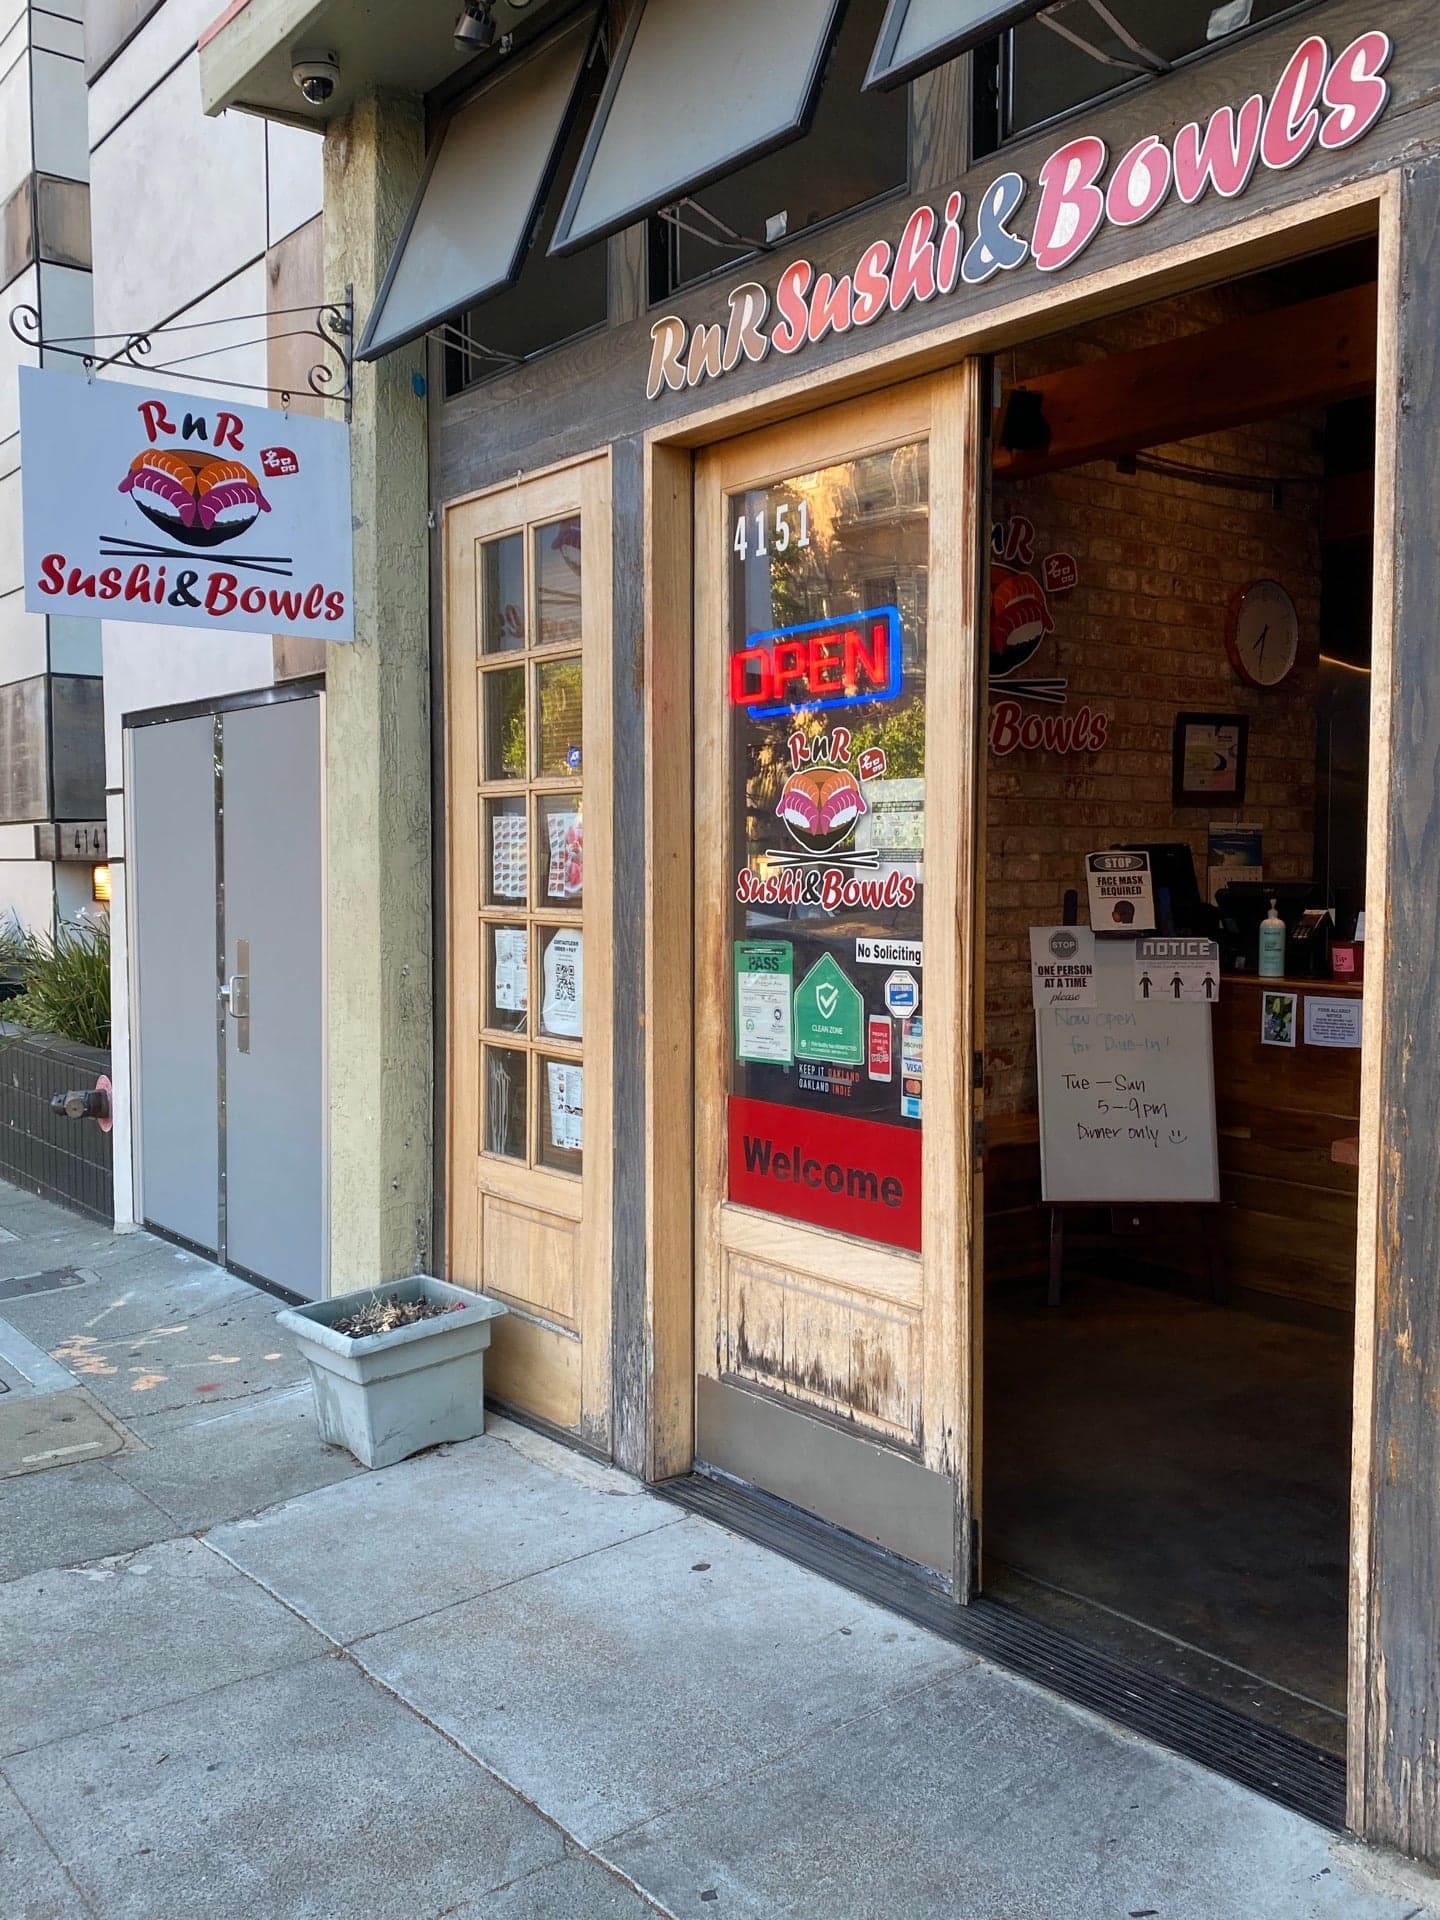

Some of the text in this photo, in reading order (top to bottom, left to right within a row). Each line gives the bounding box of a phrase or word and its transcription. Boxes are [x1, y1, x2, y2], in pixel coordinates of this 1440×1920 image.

[646, 282, 771, 400] RnR
[137, 400, 244, 451] RnR
[734, 500, 810, 561] 4151
[729, 624, 885, 705] OPEN
[788, 727, 851, 770] RnR
[1104, 858, 1133, 869] STOP
[1097, 875, 1144, 886] FACE MASK
[1100, 886, 1142, 896] REQUIRED
[858, 943, 922, 965] No Soliciting
[1051, 941, 1075, 949] STOP
[748, 956, 780, 971] PASS
[1037, 964, 1093, 976] ONE PERSON
[1044, 977, 1088, 988] AT A TIME
[1049, 992, 1080, 1004] please
[1055, 1009, 1136, 1029] Now open
[811, 1023, 843, 1035] CLEAN ZONE
[798, 1064, 860, 1082] KEEP IT OAKLAND
[905, 1062, 922, 1073] VISA
[798, 1078, 852, 1096] OAKLAND INDIE
[1061, 1074, 1090, 1090] Tue
[1113, 1074, 1145, 1092] Sun
[1077, 1123, 1159, 1148] Dinner only
[743, 1135, 903, 1208] Welcome
